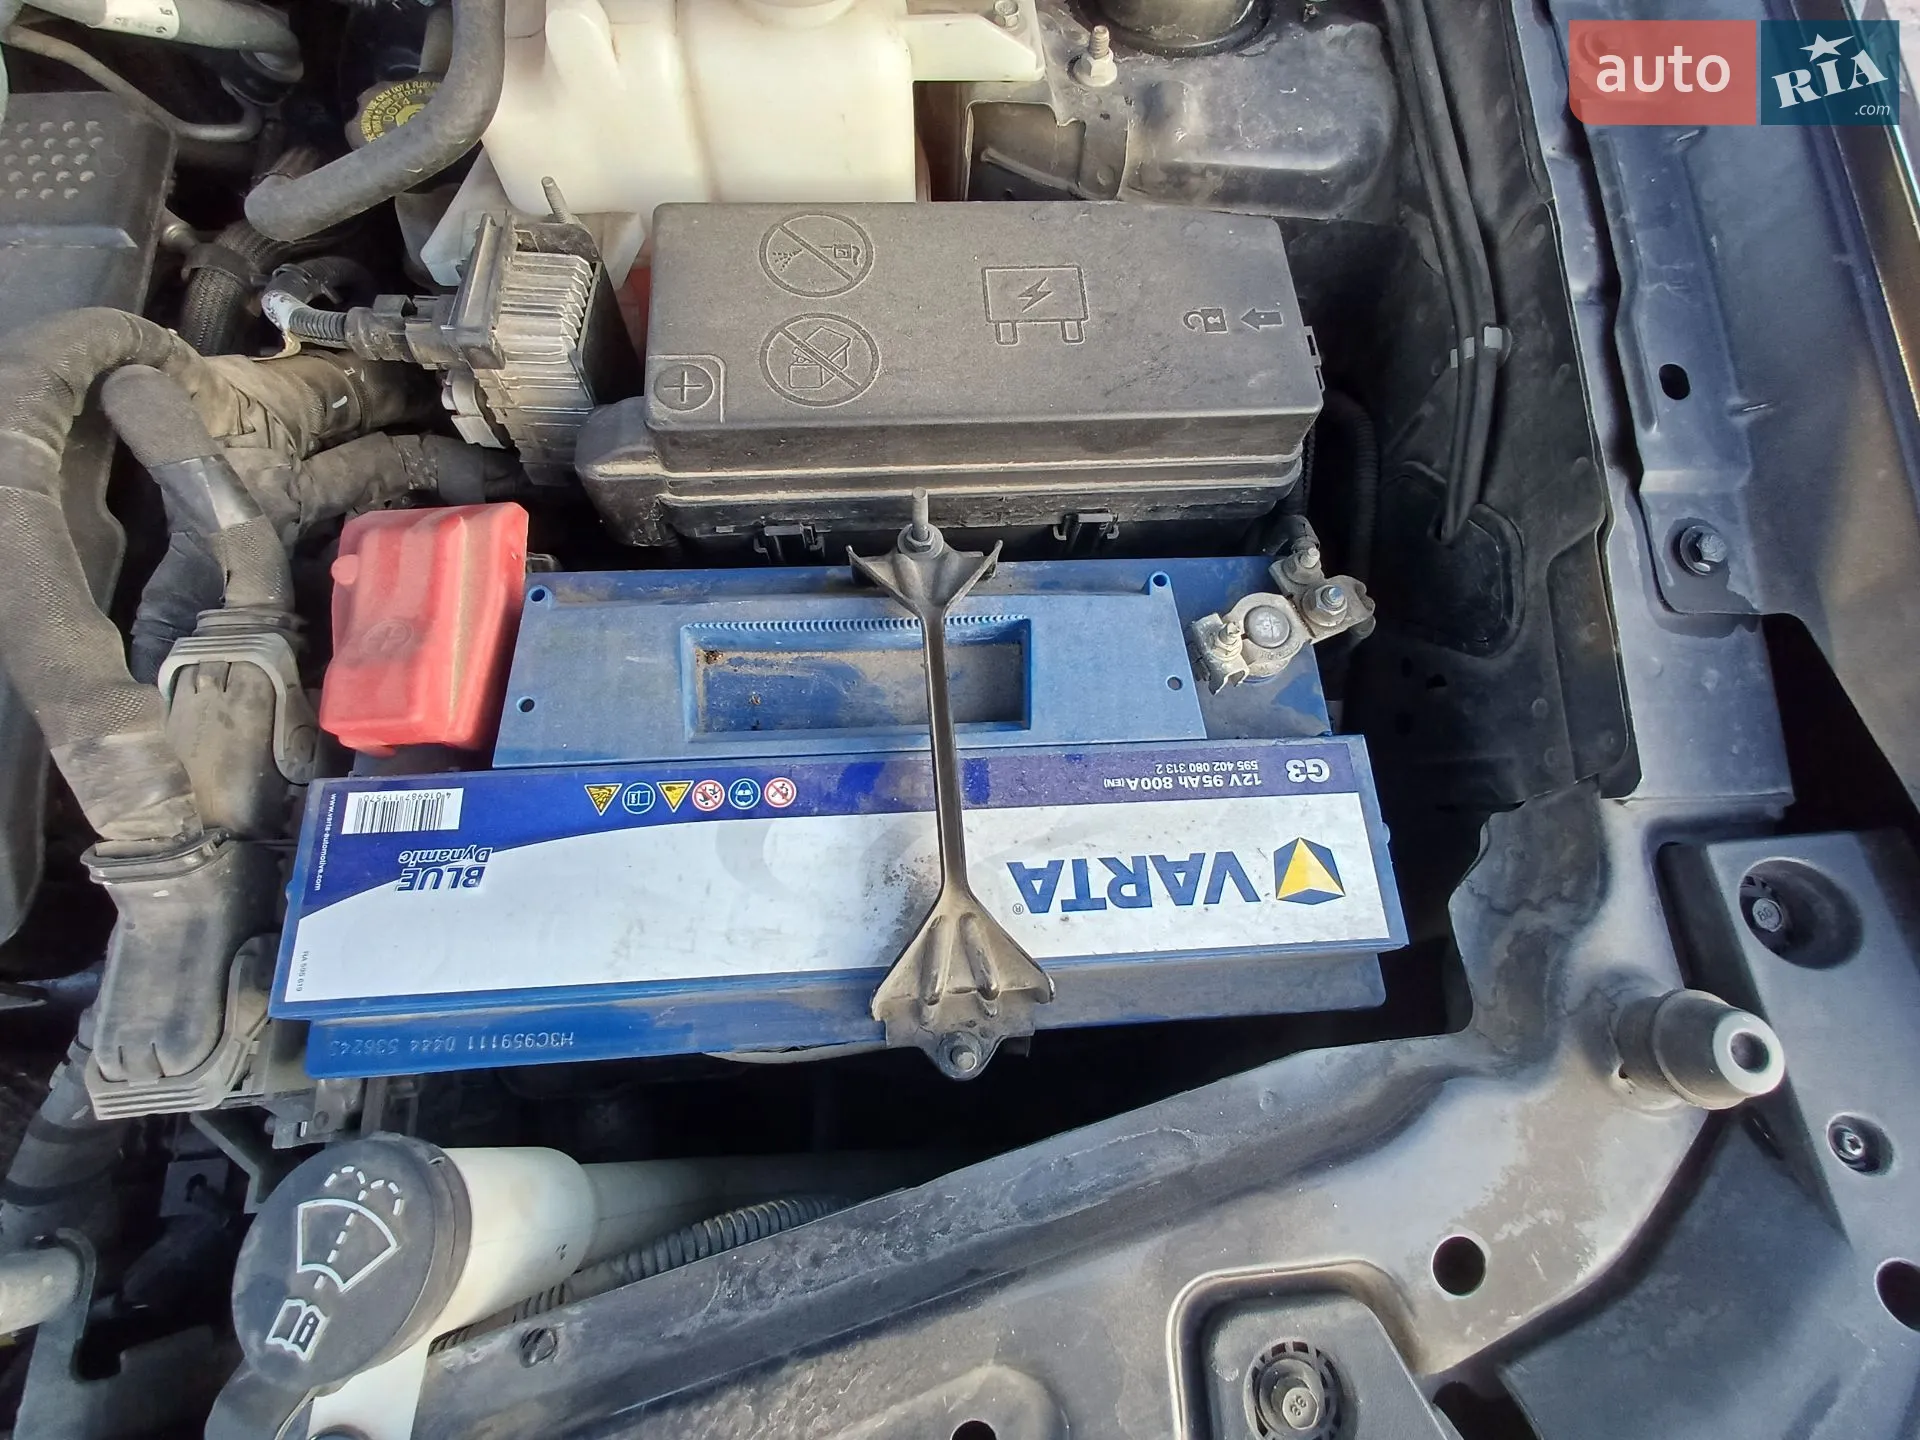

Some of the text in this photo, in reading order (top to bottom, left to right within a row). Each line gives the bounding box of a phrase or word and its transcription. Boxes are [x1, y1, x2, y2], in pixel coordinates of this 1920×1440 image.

[382, 101, 403, 122] DOT
[1156, 760, 1259, 774] 595 402 080 313 2
[1285, 758, 1330, 783] G3
[1229, 773, 1262, 787] 12V
[313, 793, 337, 891] www.varta-automotive.com
[398, 844, 493, 867] Dynamic
[396, 864, 487, 892] BLUE
